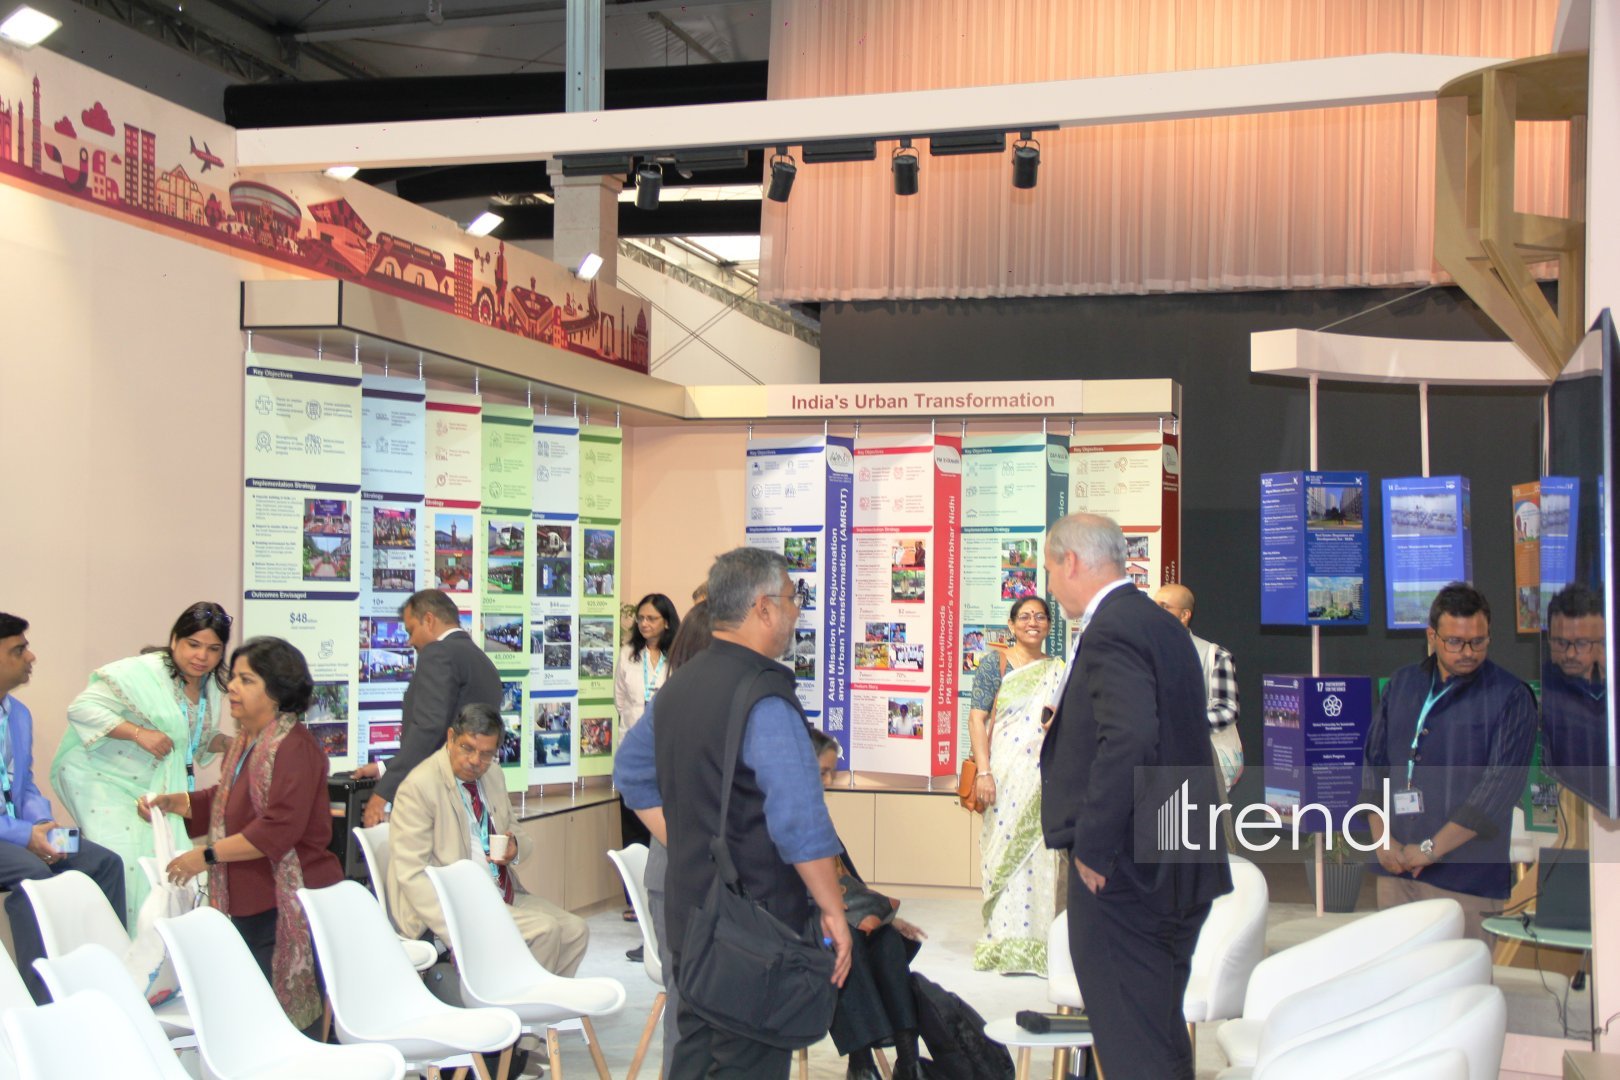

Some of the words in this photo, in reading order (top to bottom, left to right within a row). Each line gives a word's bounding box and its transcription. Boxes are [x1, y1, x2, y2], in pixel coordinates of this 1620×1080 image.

[264, 369, 293, 379] Objectives
[792, 395, 848, 410] India's
[855, 394, 908, 410] Urban
[914, 393, 1055, 409] Transformation
[252, 479, 294, 489] Implementation
[295, 481, 317, 491] Strategy
[363, 491, 384, 500] Strategy
[839, 487, 849, 542] (AMRUT)
[948, 496, 957, 524] Nidhi
[829, 527, 839, 606] Rejuvenation
[251, 591, 279, 599] Outcomes
[280, 591, 307, 600] Envisaged
[838, 544, 847, 635] Transformation
[289, 612, 308, 624] $48
[829, 609, 837, 626] for
[946, 600, 955, 649] Vendor's
[938, 605, 947, 668] Livelihoods
[828, 629, 837, 674] Mission
[838, 638, 846, 676] Urban
[946, 651, 954, 686] Street
[828, 677, 836, 702] Atal
[837, 678, 845, 702] and
[938, 670, 946, 704] Urban
[945, 688, 953, 704] PM
[1316, 681, 1324, 692] 17
